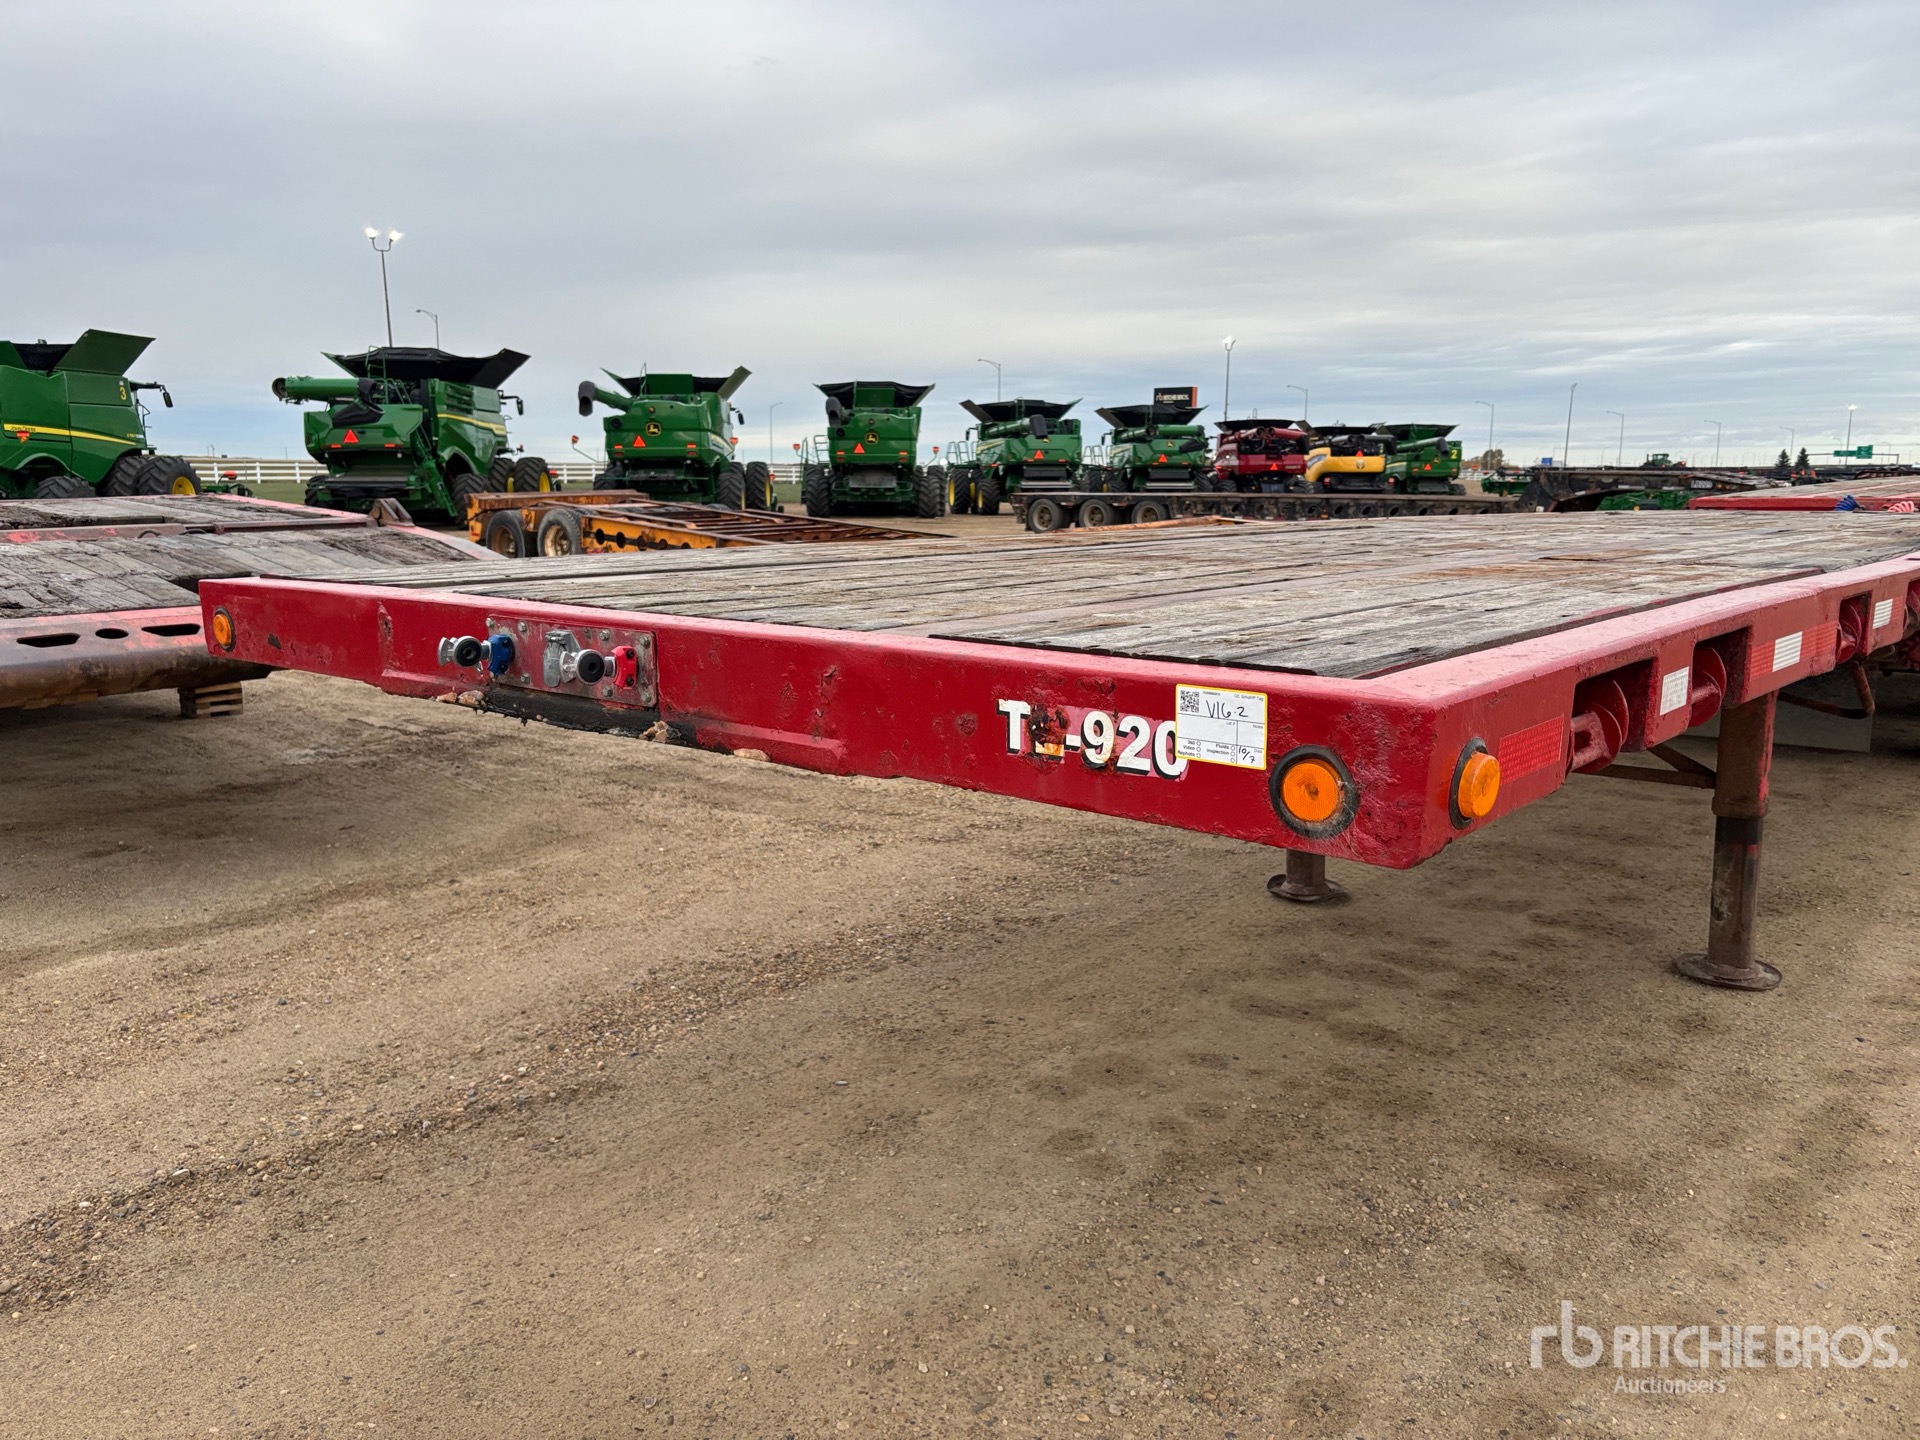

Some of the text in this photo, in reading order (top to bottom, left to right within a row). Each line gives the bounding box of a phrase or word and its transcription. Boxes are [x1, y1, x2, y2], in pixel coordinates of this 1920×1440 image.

[119, 386, 127, 401] 3
[1450, 449, 1458, 460] 2
[1238, 746, 1256, 764] 10/7
